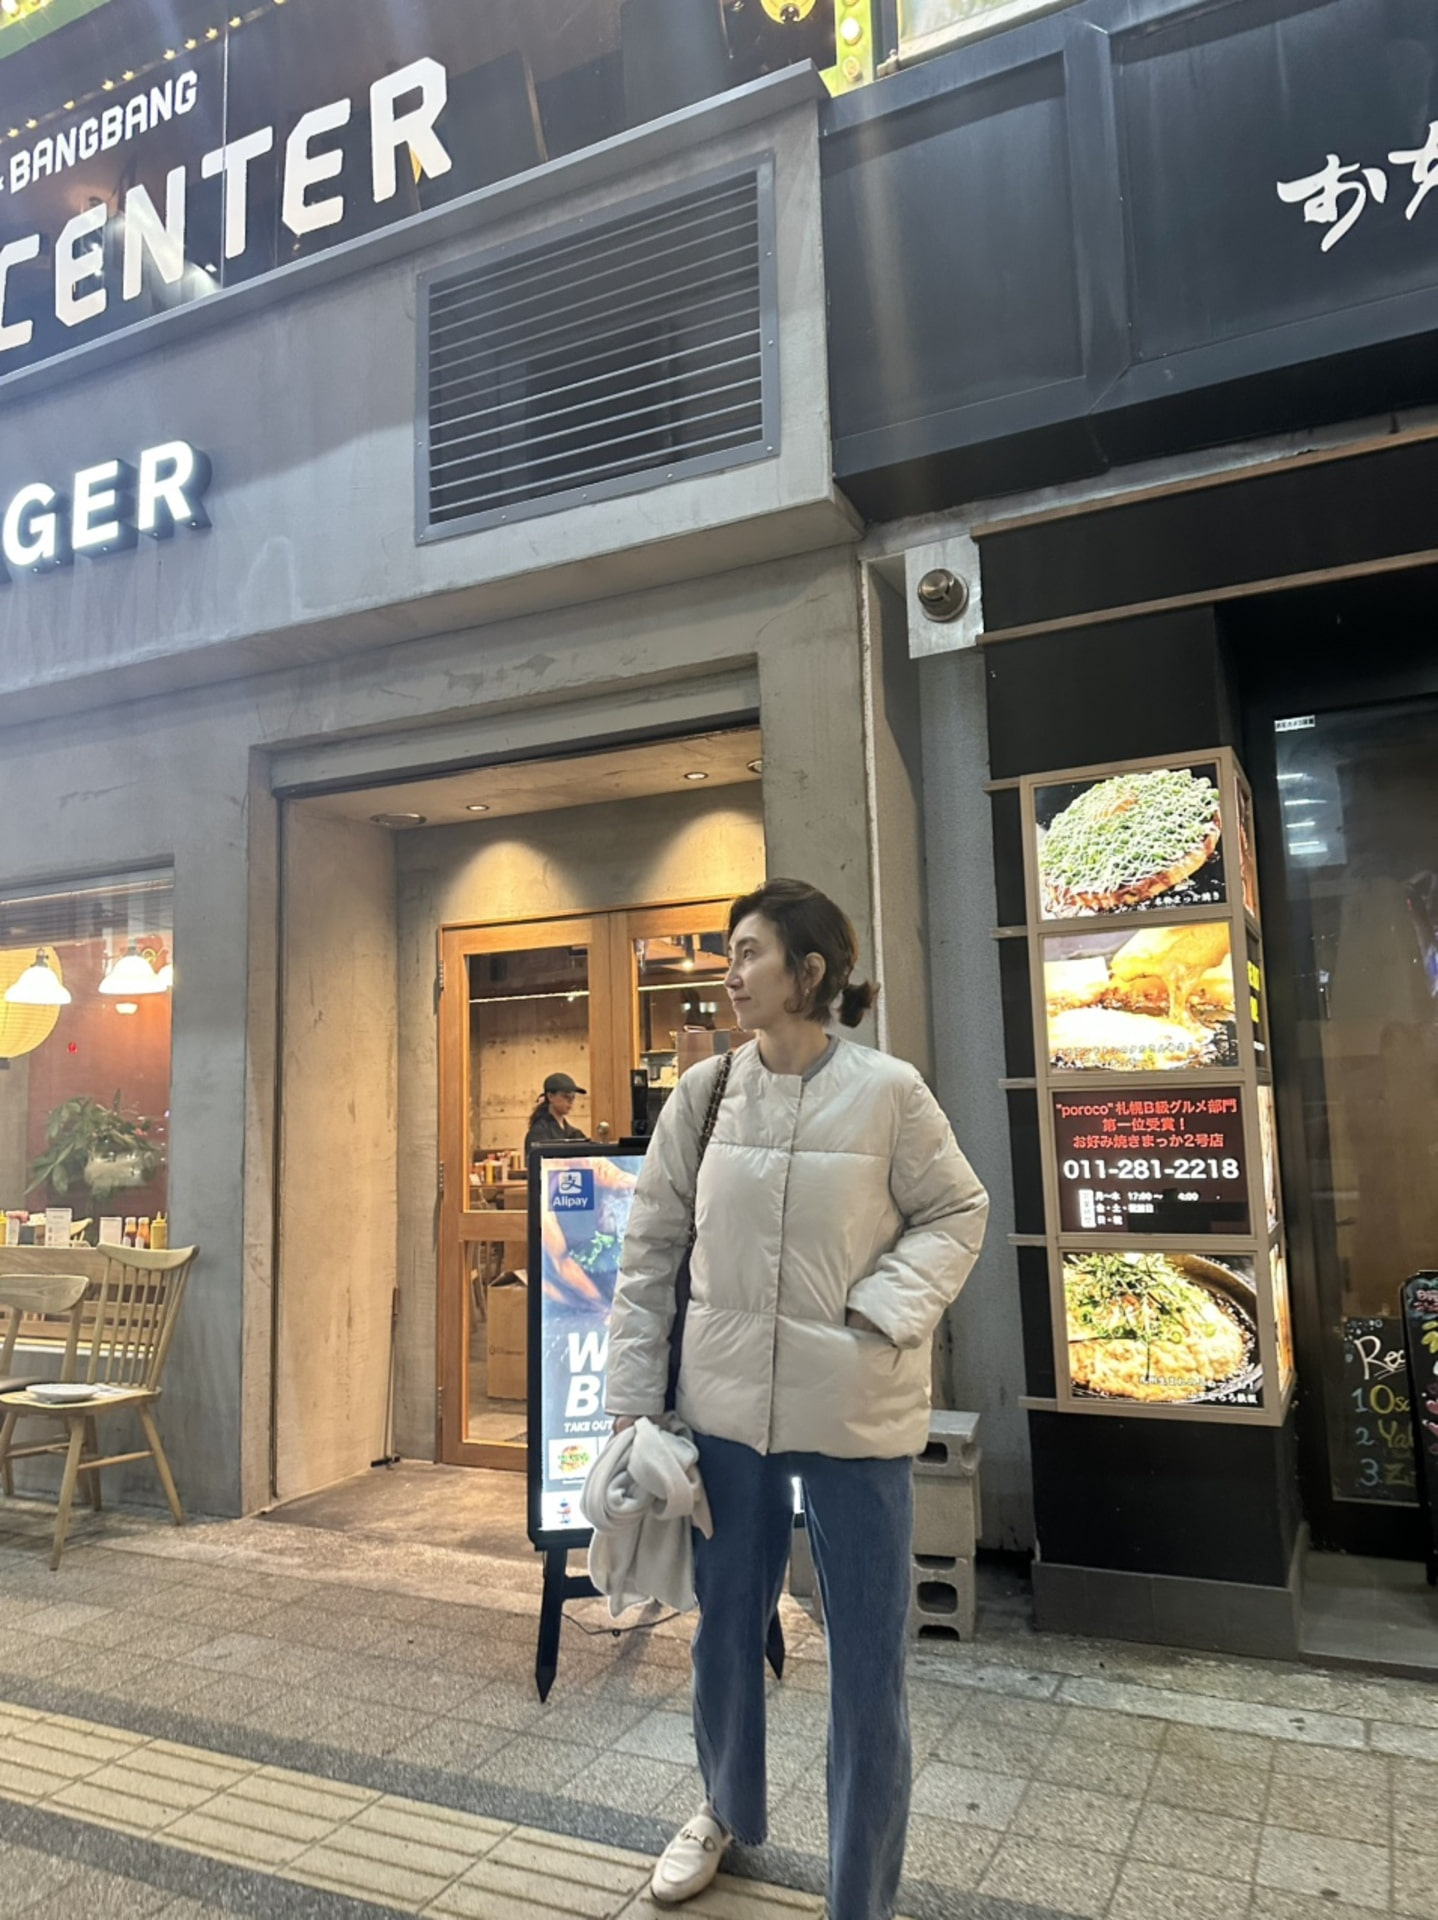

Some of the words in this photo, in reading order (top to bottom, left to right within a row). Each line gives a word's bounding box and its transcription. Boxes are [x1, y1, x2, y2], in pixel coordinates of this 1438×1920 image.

[10, 70, 198, 194] BANGBANG
[0, 57, 452, 350] CENTER
[1073, 1133, 1224, 1149] お好み焼きまっか2号店
[1063, 1158, 1239, 1180] 011-281-2218
[553, 1196, 588, 1208] Alipay
[565, 1374, 607, 1417] B
[564, 1421, 590, 1433] TAKE
[592, 1420, 614, 1431] OUT
[1360, 1458, 1379, 1487] 3
